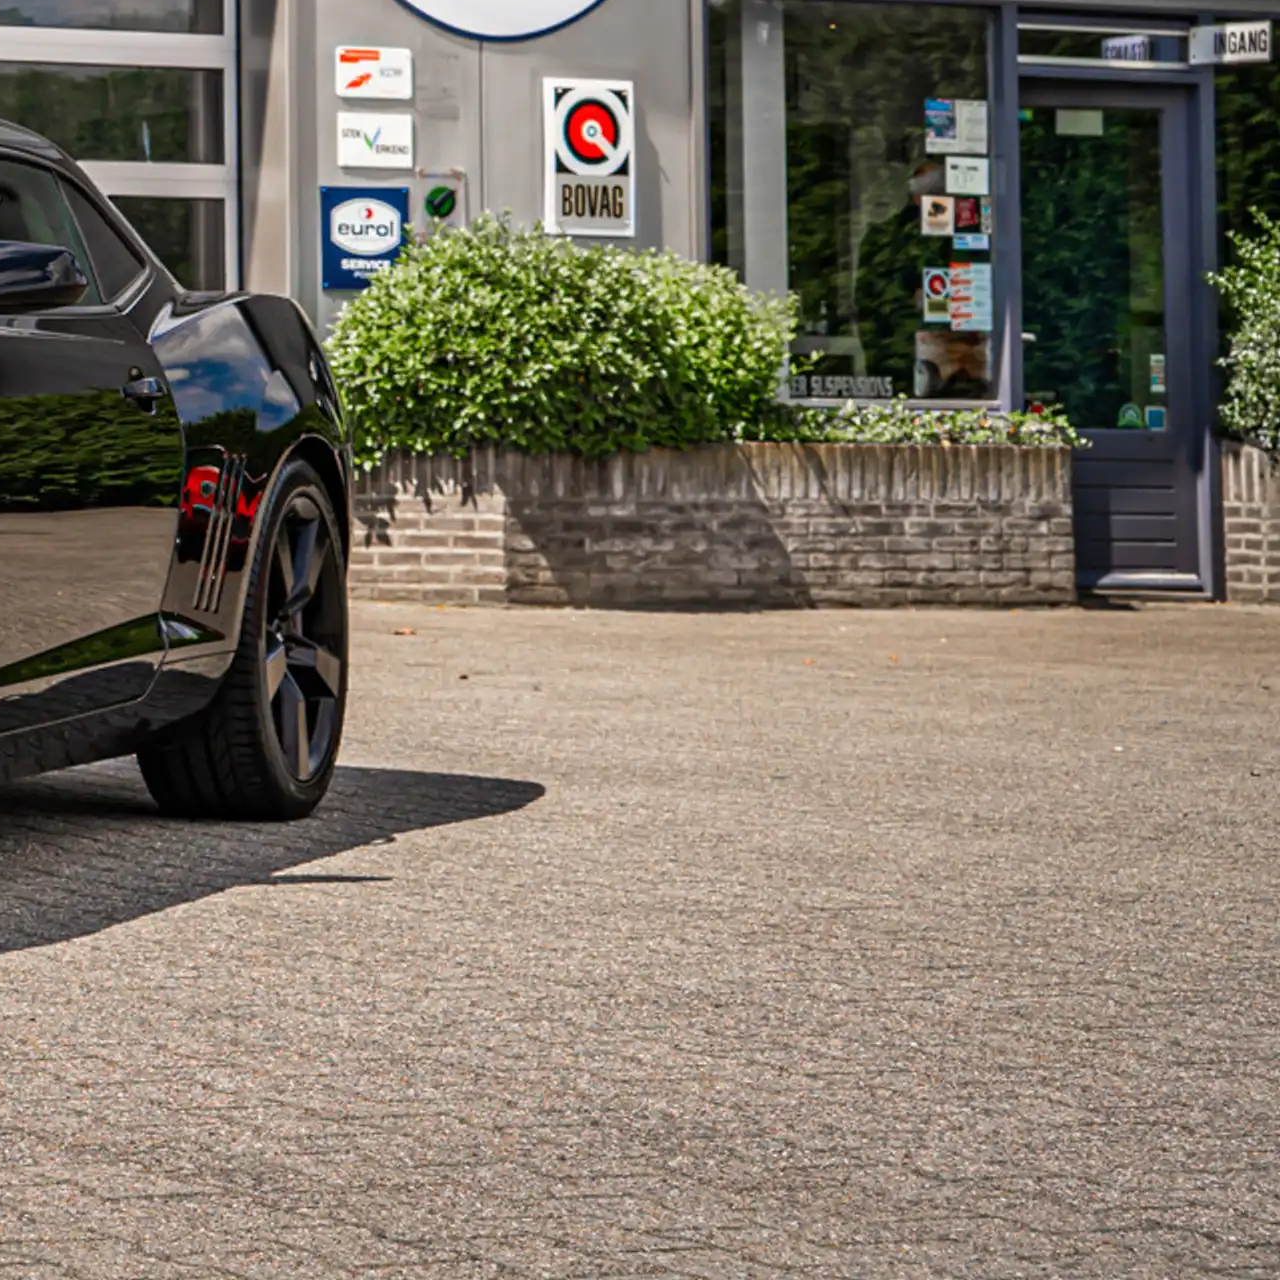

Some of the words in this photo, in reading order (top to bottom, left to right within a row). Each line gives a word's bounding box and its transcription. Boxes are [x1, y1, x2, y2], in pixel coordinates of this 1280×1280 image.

[1214, 29, 1269, 55] INGANG
[562, 184, 624, 219] BOVAG
[338, 220, 394, 237] eurol
